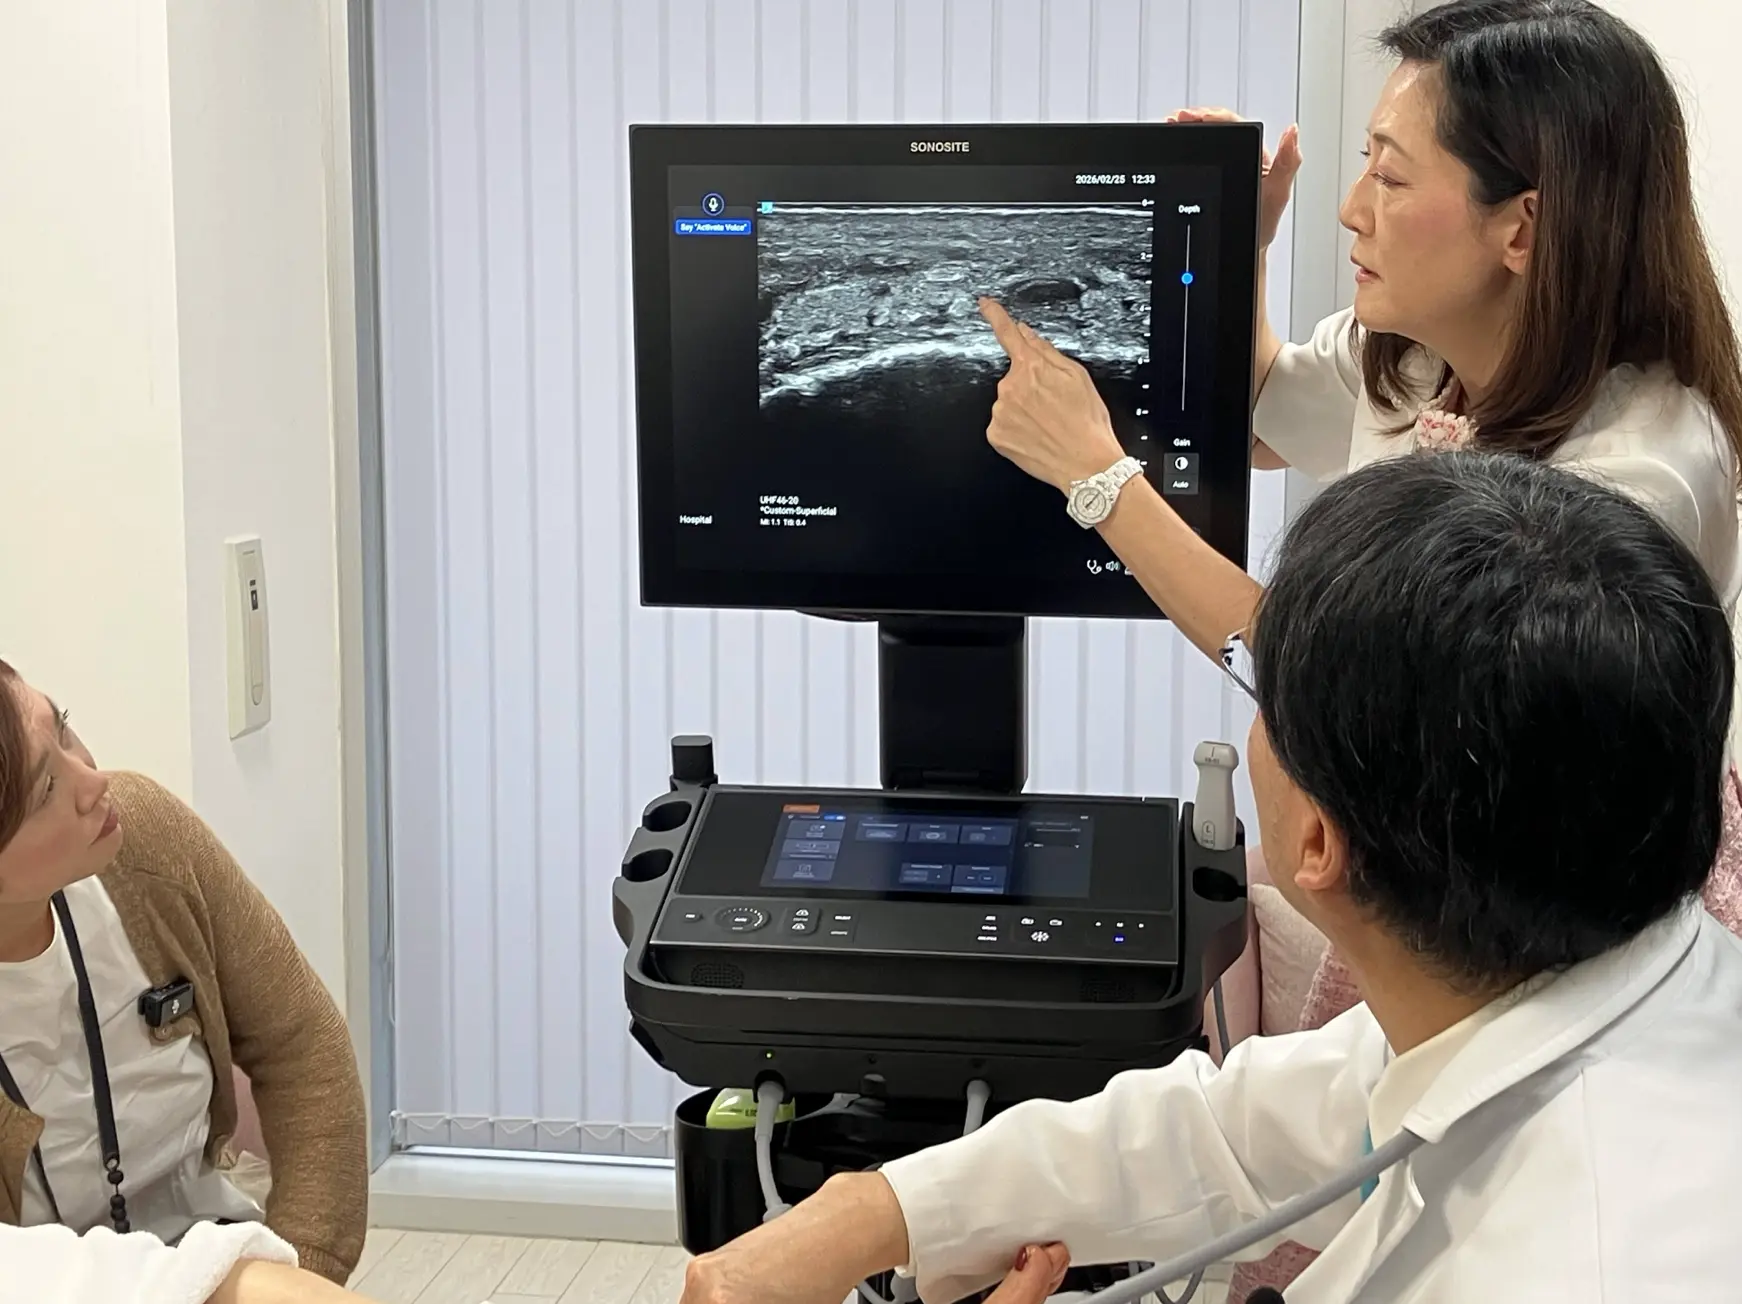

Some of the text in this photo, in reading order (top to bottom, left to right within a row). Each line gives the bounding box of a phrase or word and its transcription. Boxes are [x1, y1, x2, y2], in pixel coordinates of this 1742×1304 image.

[910, 141, 970, 153] SONOSITE
[1075, 174, 1156, 184] 2026/02/25 12:33
[1178, 205, 1201, 215] Depth
[680, 223, 694, 233] Say
[1173, 438, 1191, 447] Gain
[1172, 480, 1189, 489] Auto
[760, 495, 800, 505] UHF46-20
[679, 515, 713, 525] Hospital
